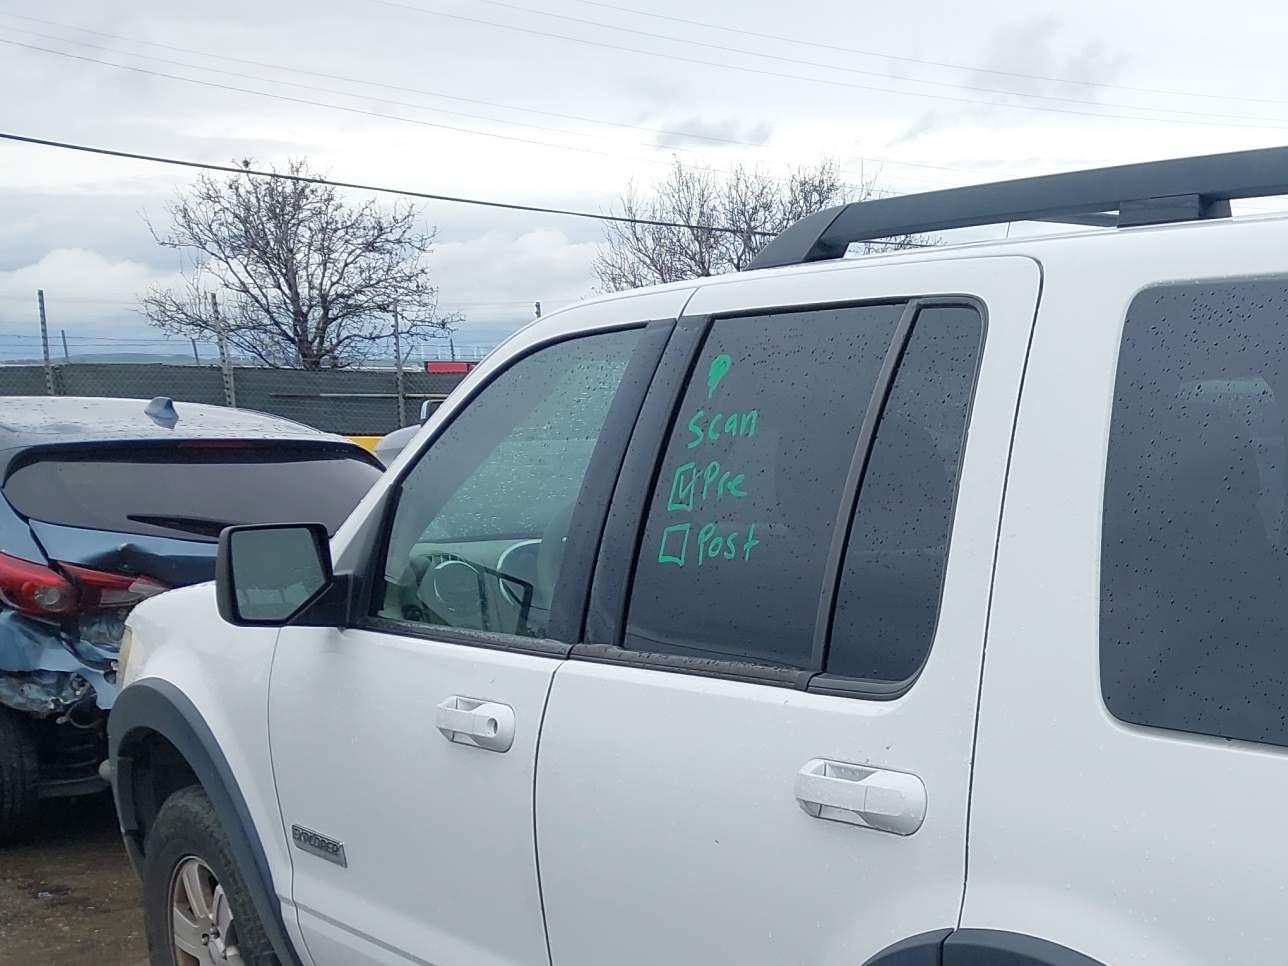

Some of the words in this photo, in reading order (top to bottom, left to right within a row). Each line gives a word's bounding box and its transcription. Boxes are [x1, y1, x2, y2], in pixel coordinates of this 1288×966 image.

[687, 408, 759, 449] Scan
[701, 460, 748, 500] Pre
[696, 522, 761, 566] Post
